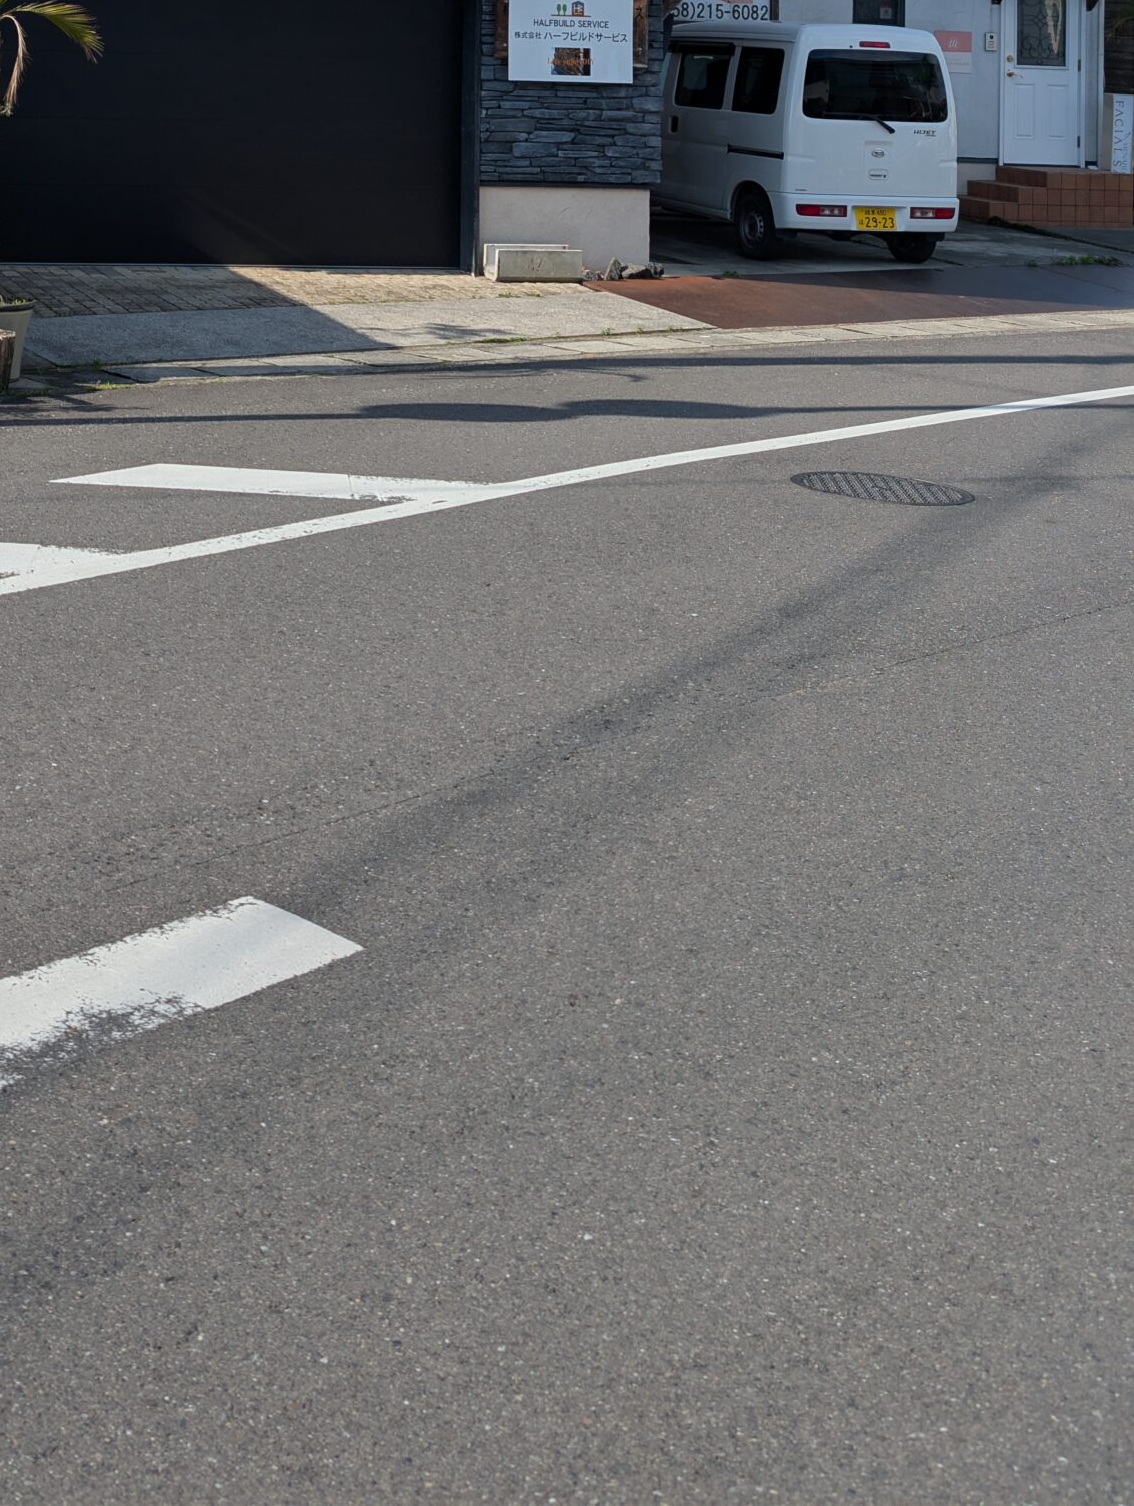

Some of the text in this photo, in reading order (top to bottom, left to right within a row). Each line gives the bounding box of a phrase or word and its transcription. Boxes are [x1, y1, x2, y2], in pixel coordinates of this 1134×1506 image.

[533, 18, 610, 29] HALFBUILD SERVICE
[543, 32, 628, 43] ハーフビルドサービス
[865, 216, 895, 229] 29-23
